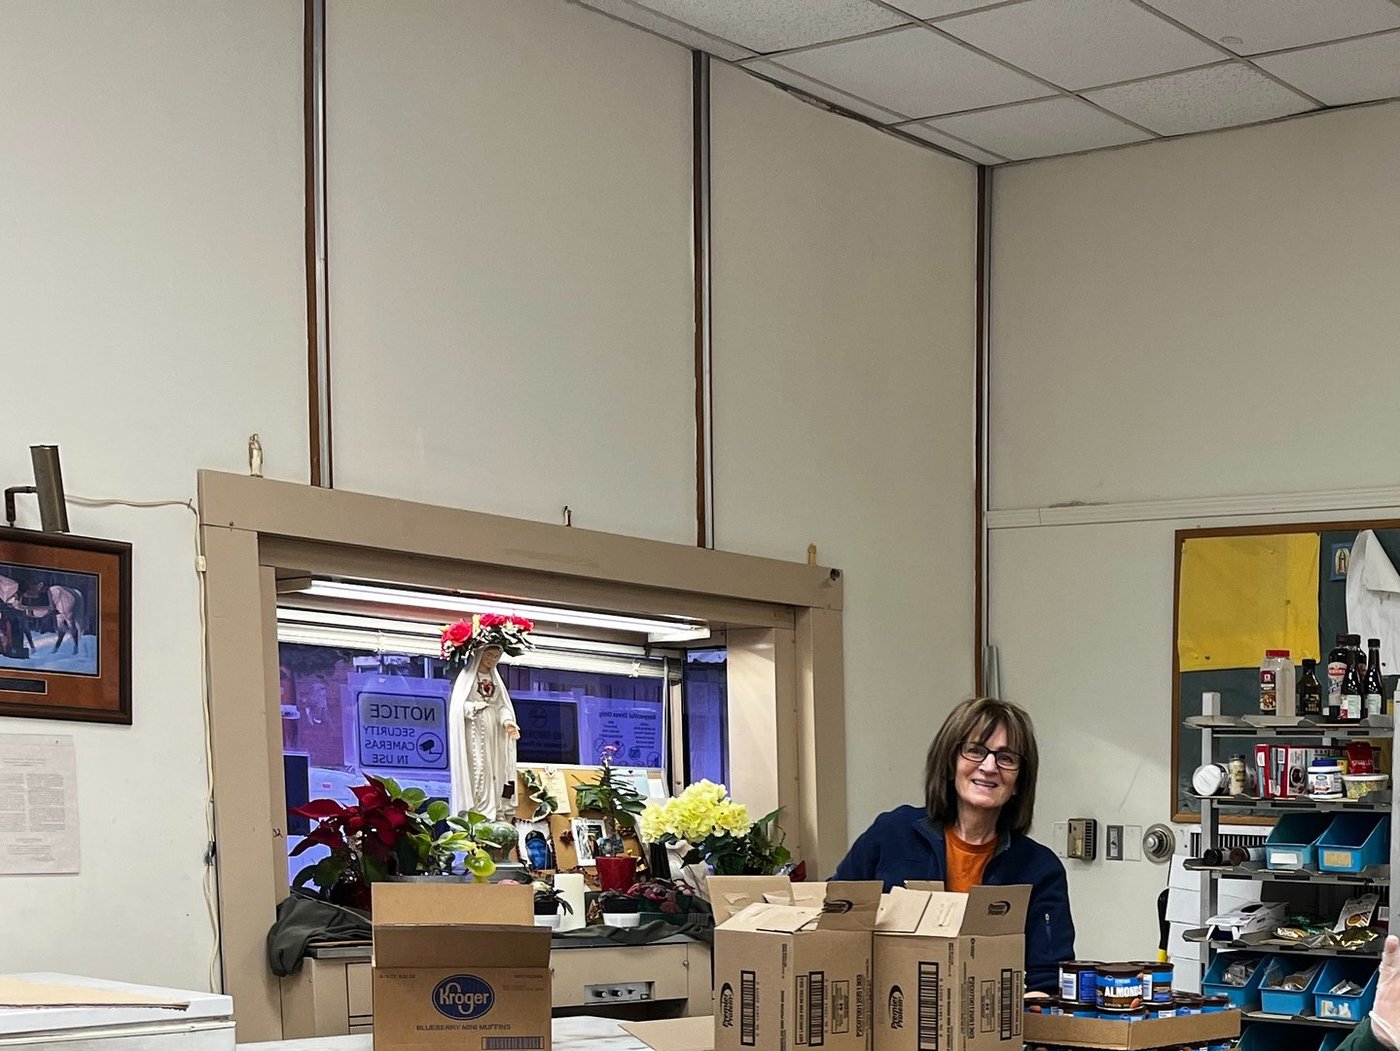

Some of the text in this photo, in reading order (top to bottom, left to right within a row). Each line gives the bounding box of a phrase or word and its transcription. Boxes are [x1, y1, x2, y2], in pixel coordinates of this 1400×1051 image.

[439, 982, 489, 1015] Kroger
[1104, 985, 1143, 997] ALMONDS
[722, 993, 730, 1027] Premier
[890, 995, 898, 1029] Premier
[896, 997, 904, 1029] Protein
[479, 1023, 511, 1031] MUFFINS
